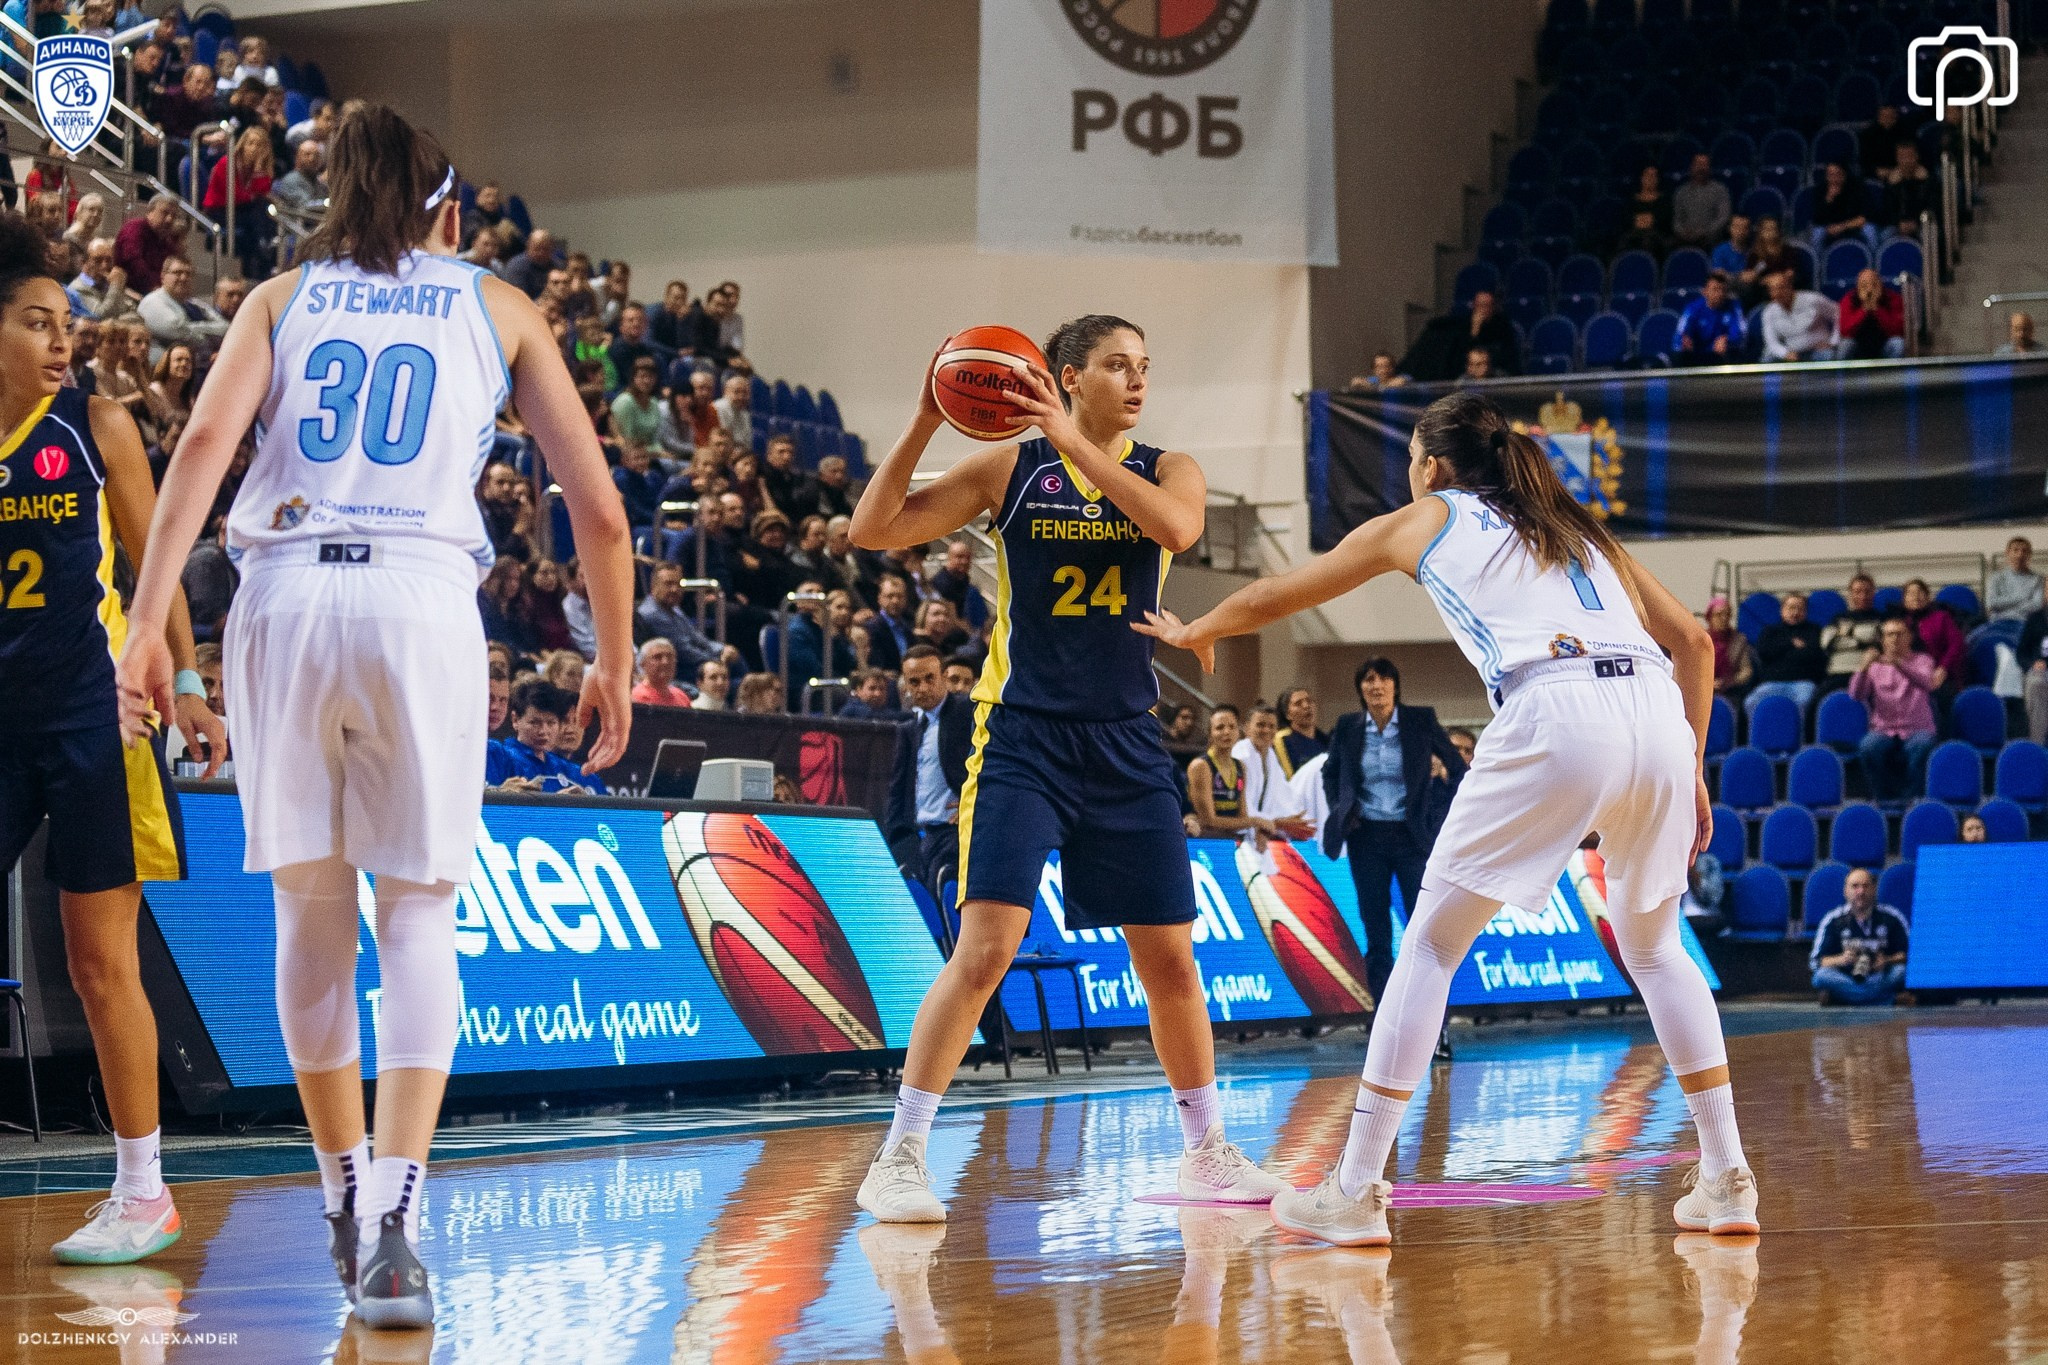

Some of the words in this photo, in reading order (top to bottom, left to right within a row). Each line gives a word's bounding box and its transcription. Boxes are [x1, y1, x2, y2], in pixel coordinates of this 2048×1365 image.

[1072, 88, 1243, 158] РФБ
[306, 279, 461, 320] STEWART
[298, 339, 436, 466] 30
[955, 368, 1023, 395] molten
[970, 406, 997, 422] FIBA
[0, 493, 79, 524] BAHÇE
[1031, 519, 1141, 543] FENERBAHÇ
[0, 549, 46, 609] 2
[1052, 565, 1127, 616] 24
[1079, 963, 1120, 1014] For
[1474, 950, 1505, 992] For
[455, 979, 510, 1047] he
[515, 977, 595, 1045] real
[601, 1000, 700, 1065] game
[1211, 973, 1272, 1021] game
